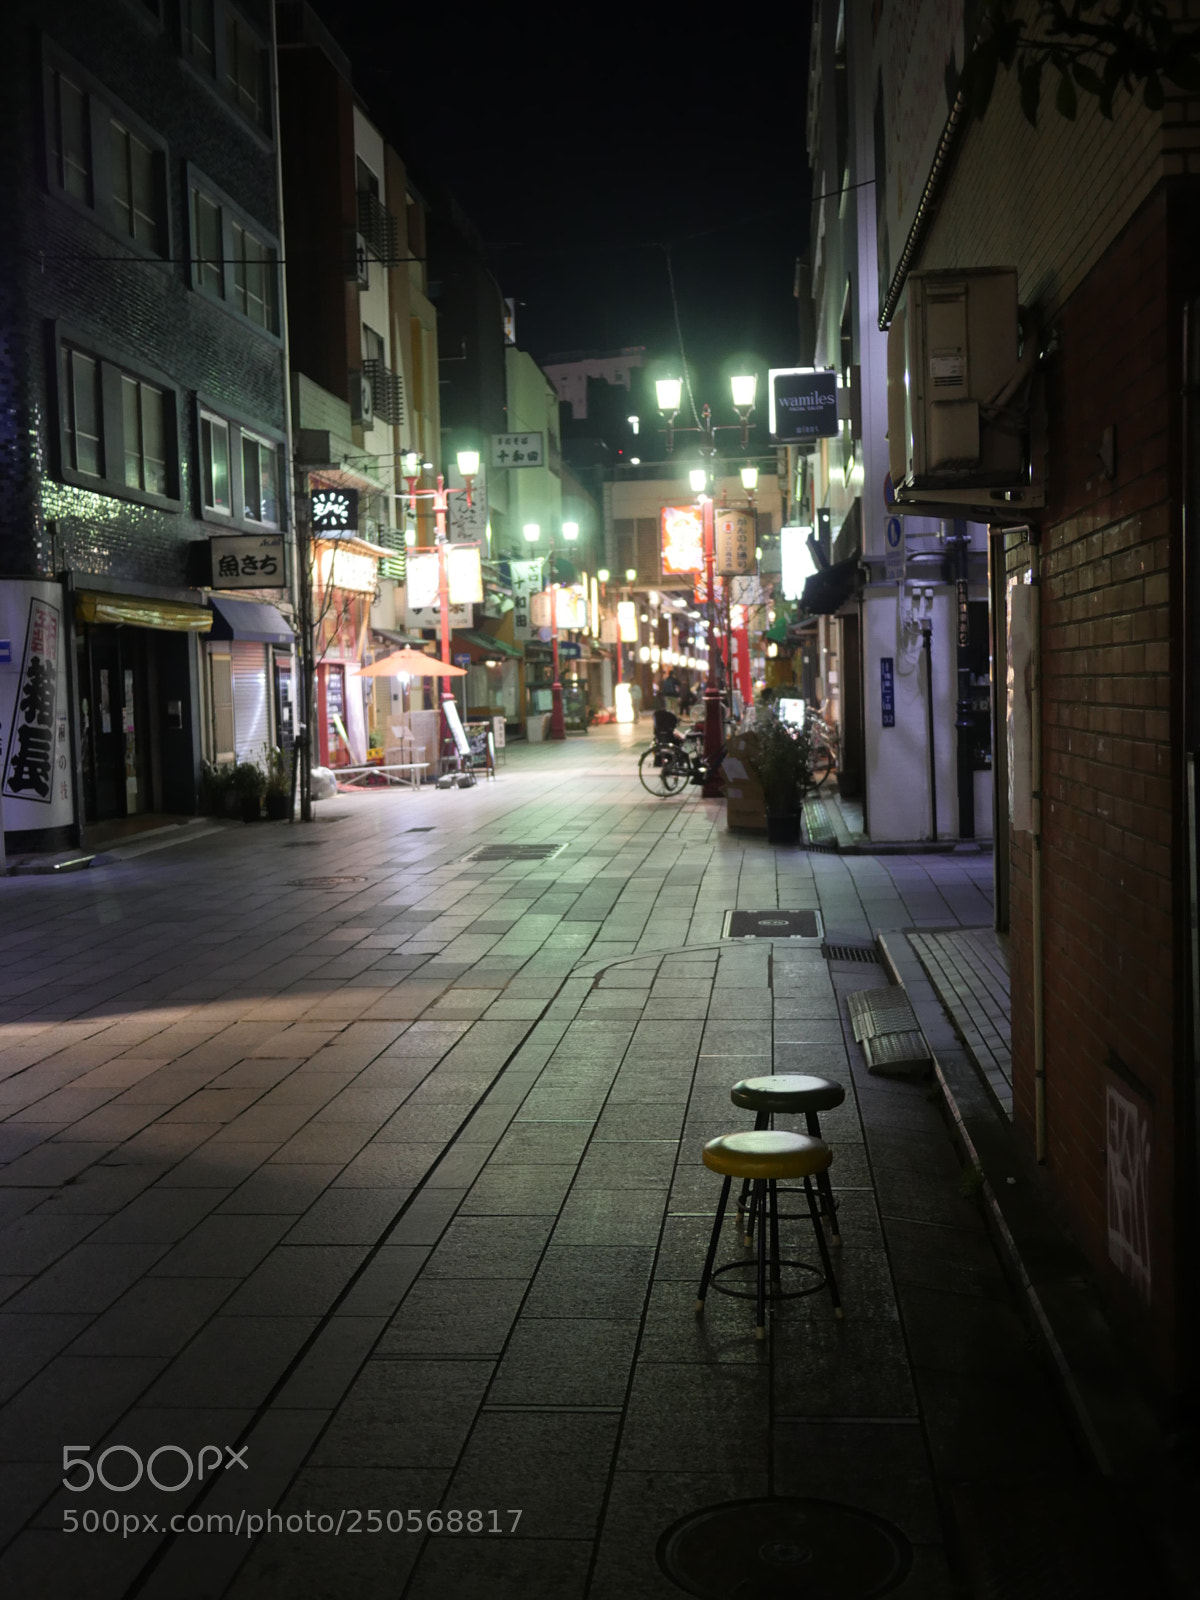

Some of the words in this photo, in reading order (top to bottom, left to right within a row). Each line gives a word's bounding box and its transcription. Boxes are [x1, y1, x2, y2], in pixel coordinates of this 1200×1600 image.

[778, 389, 835, 408] wamiles
[496, 449, 539, 463] 十和田
[218, 554, 277, 577] 魚きち
